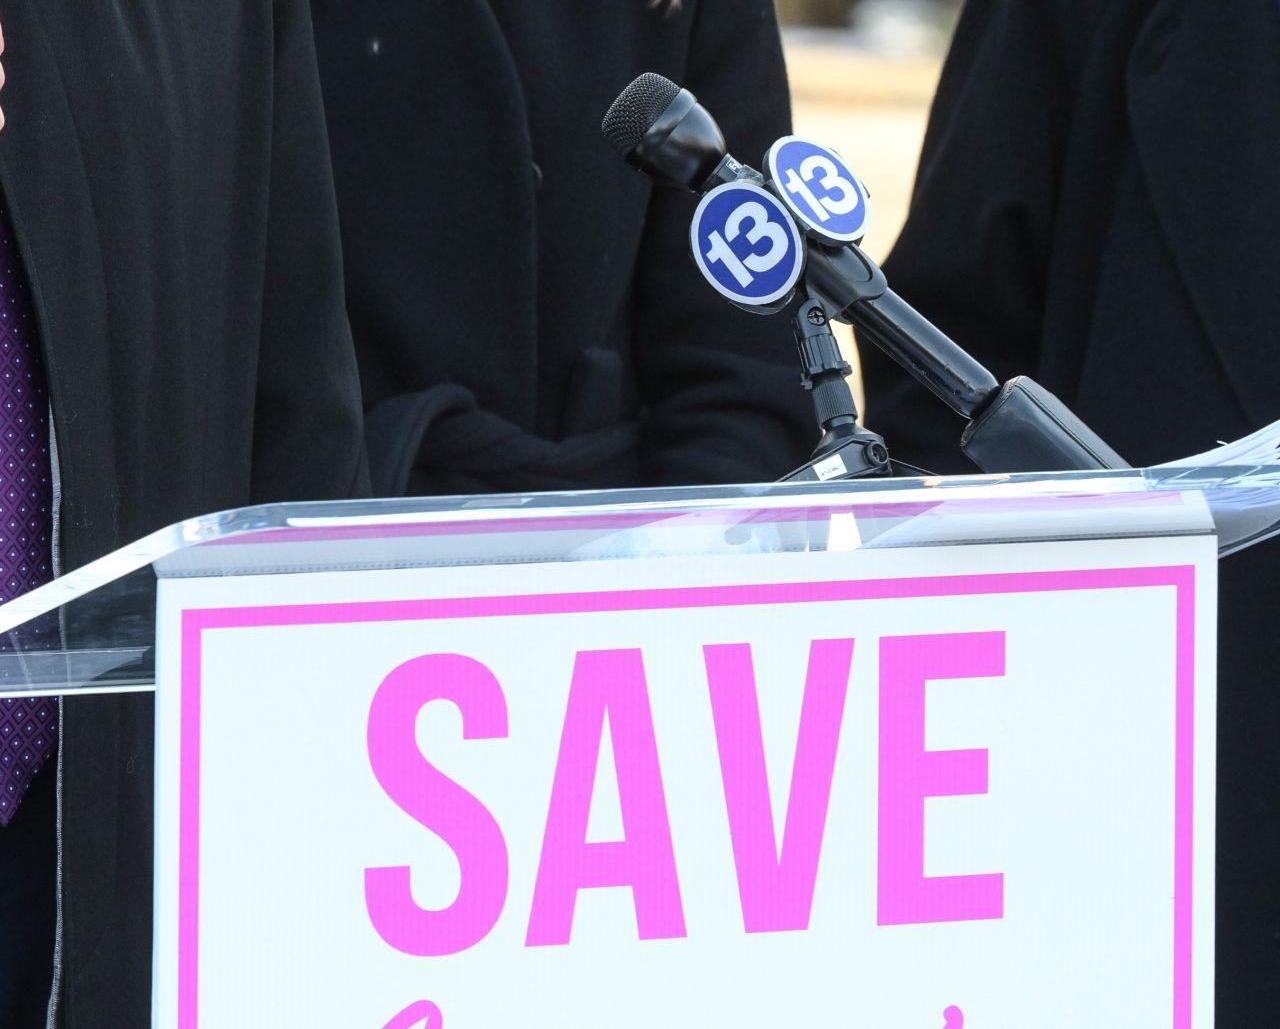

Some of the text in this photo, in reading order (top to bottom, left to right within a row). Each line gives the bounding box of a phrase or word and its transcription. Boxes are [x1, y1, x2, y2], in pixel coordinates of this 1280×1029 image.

[785, 154, 859, 222] 13
[706, 201, 789, 288] 13
[364, 630, 1006, 957] SAVE
